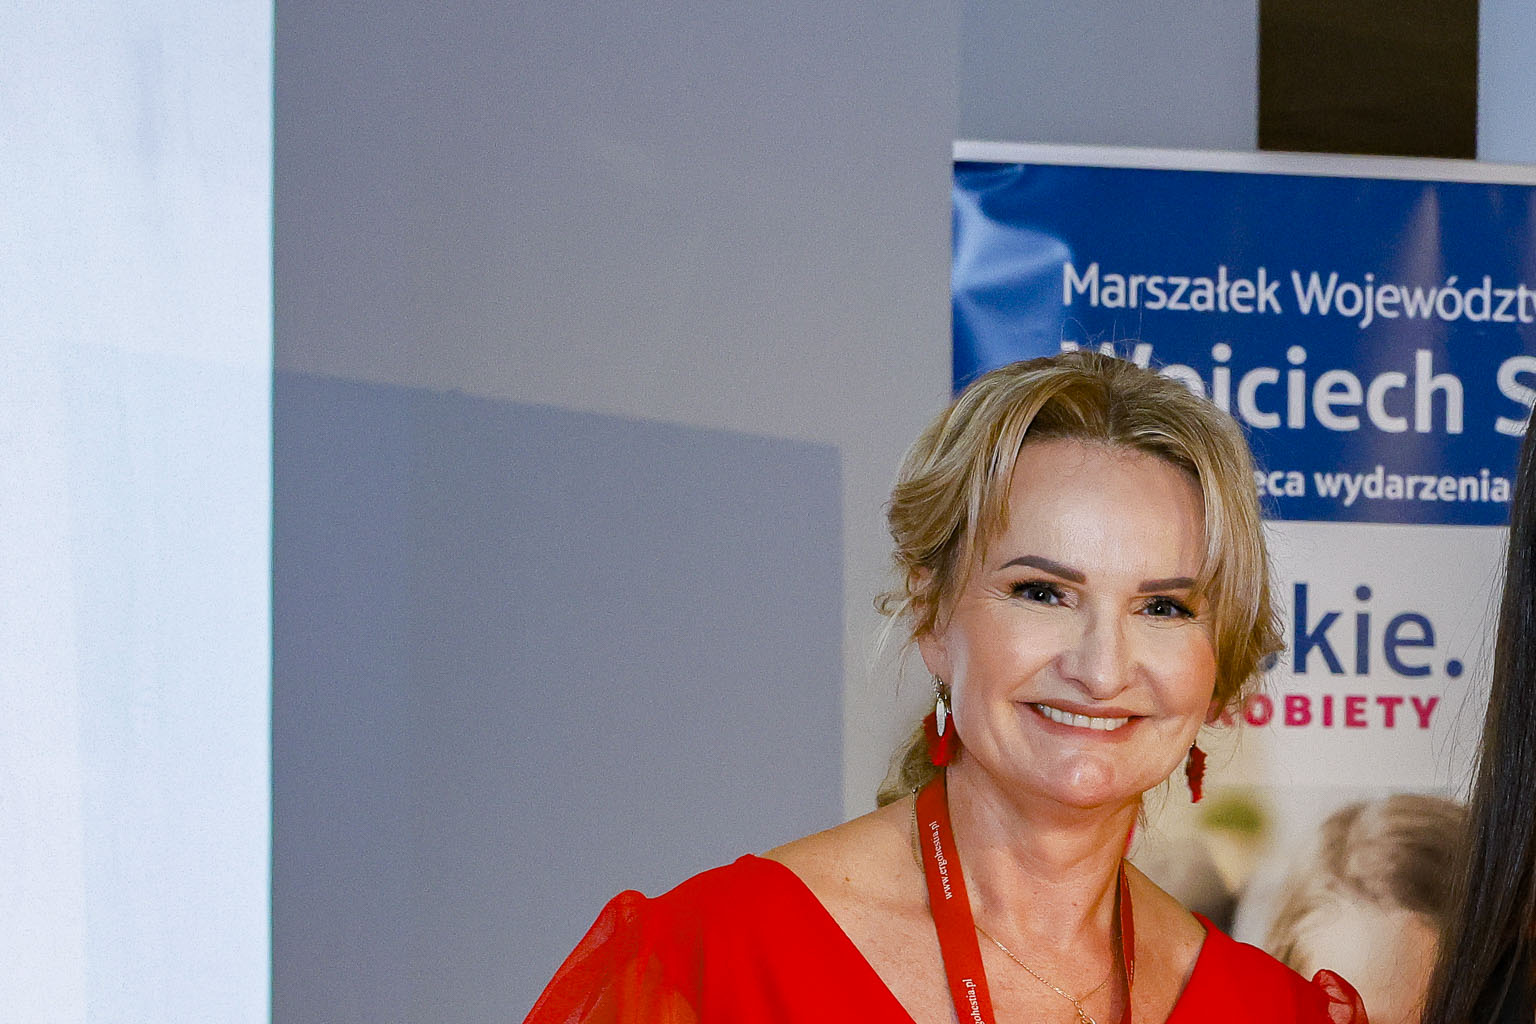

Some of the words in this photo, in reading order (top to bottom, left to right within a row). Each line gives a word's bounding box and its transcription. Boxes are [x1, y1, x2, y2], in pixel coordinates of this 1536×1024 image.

[1063, 262, 1282, 314] Marszałek
[1061, 341, 1464, 434] jciech
[1314, 465, 1511, 507] wydarzenia
[1262, 582, 1464, 677] kie.
